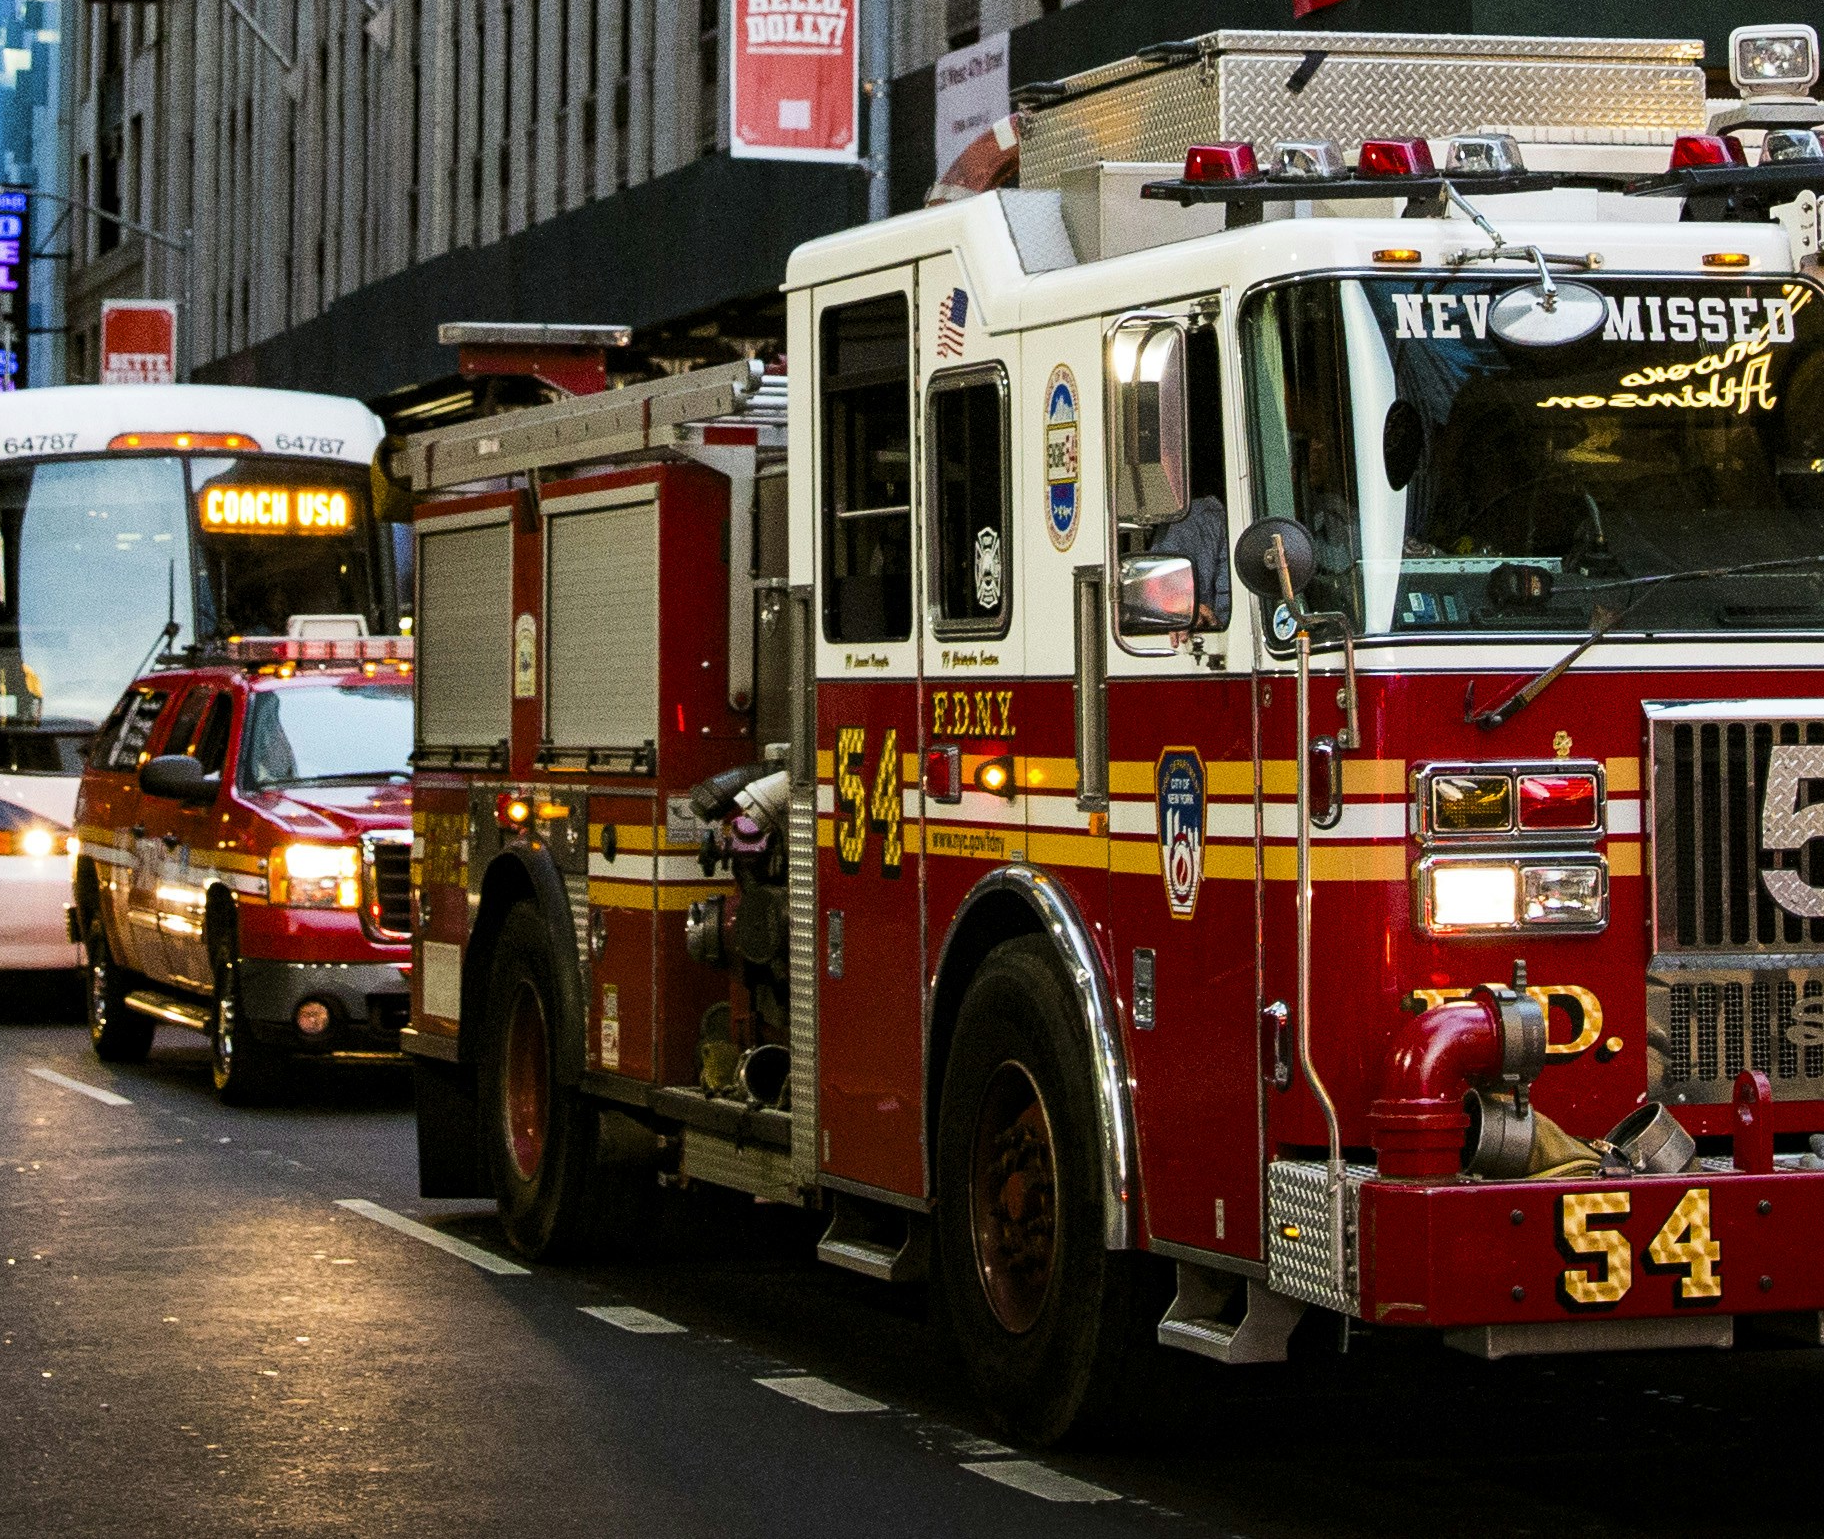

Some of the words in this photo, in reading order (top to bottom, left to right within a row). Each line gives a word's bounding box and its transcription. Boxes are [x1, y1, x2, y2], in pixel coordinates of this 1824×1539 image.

[746, 13, 846, 48] DOLLY!
[1392, 293, 1502, 340] NEV
[1603, 296, 1795, 343] MISSED
[4, 431, 77, 456] 64787
[276, 432, 346, 457] 64787
[207, 488, 288, 528] COACH
[297, 489, 346, 528] USA
[932, 691, 1016, 738] F.D.N.Y.
[836, 727, 903, 868] 54
[1559, 1187, 1722, 1304] 54
